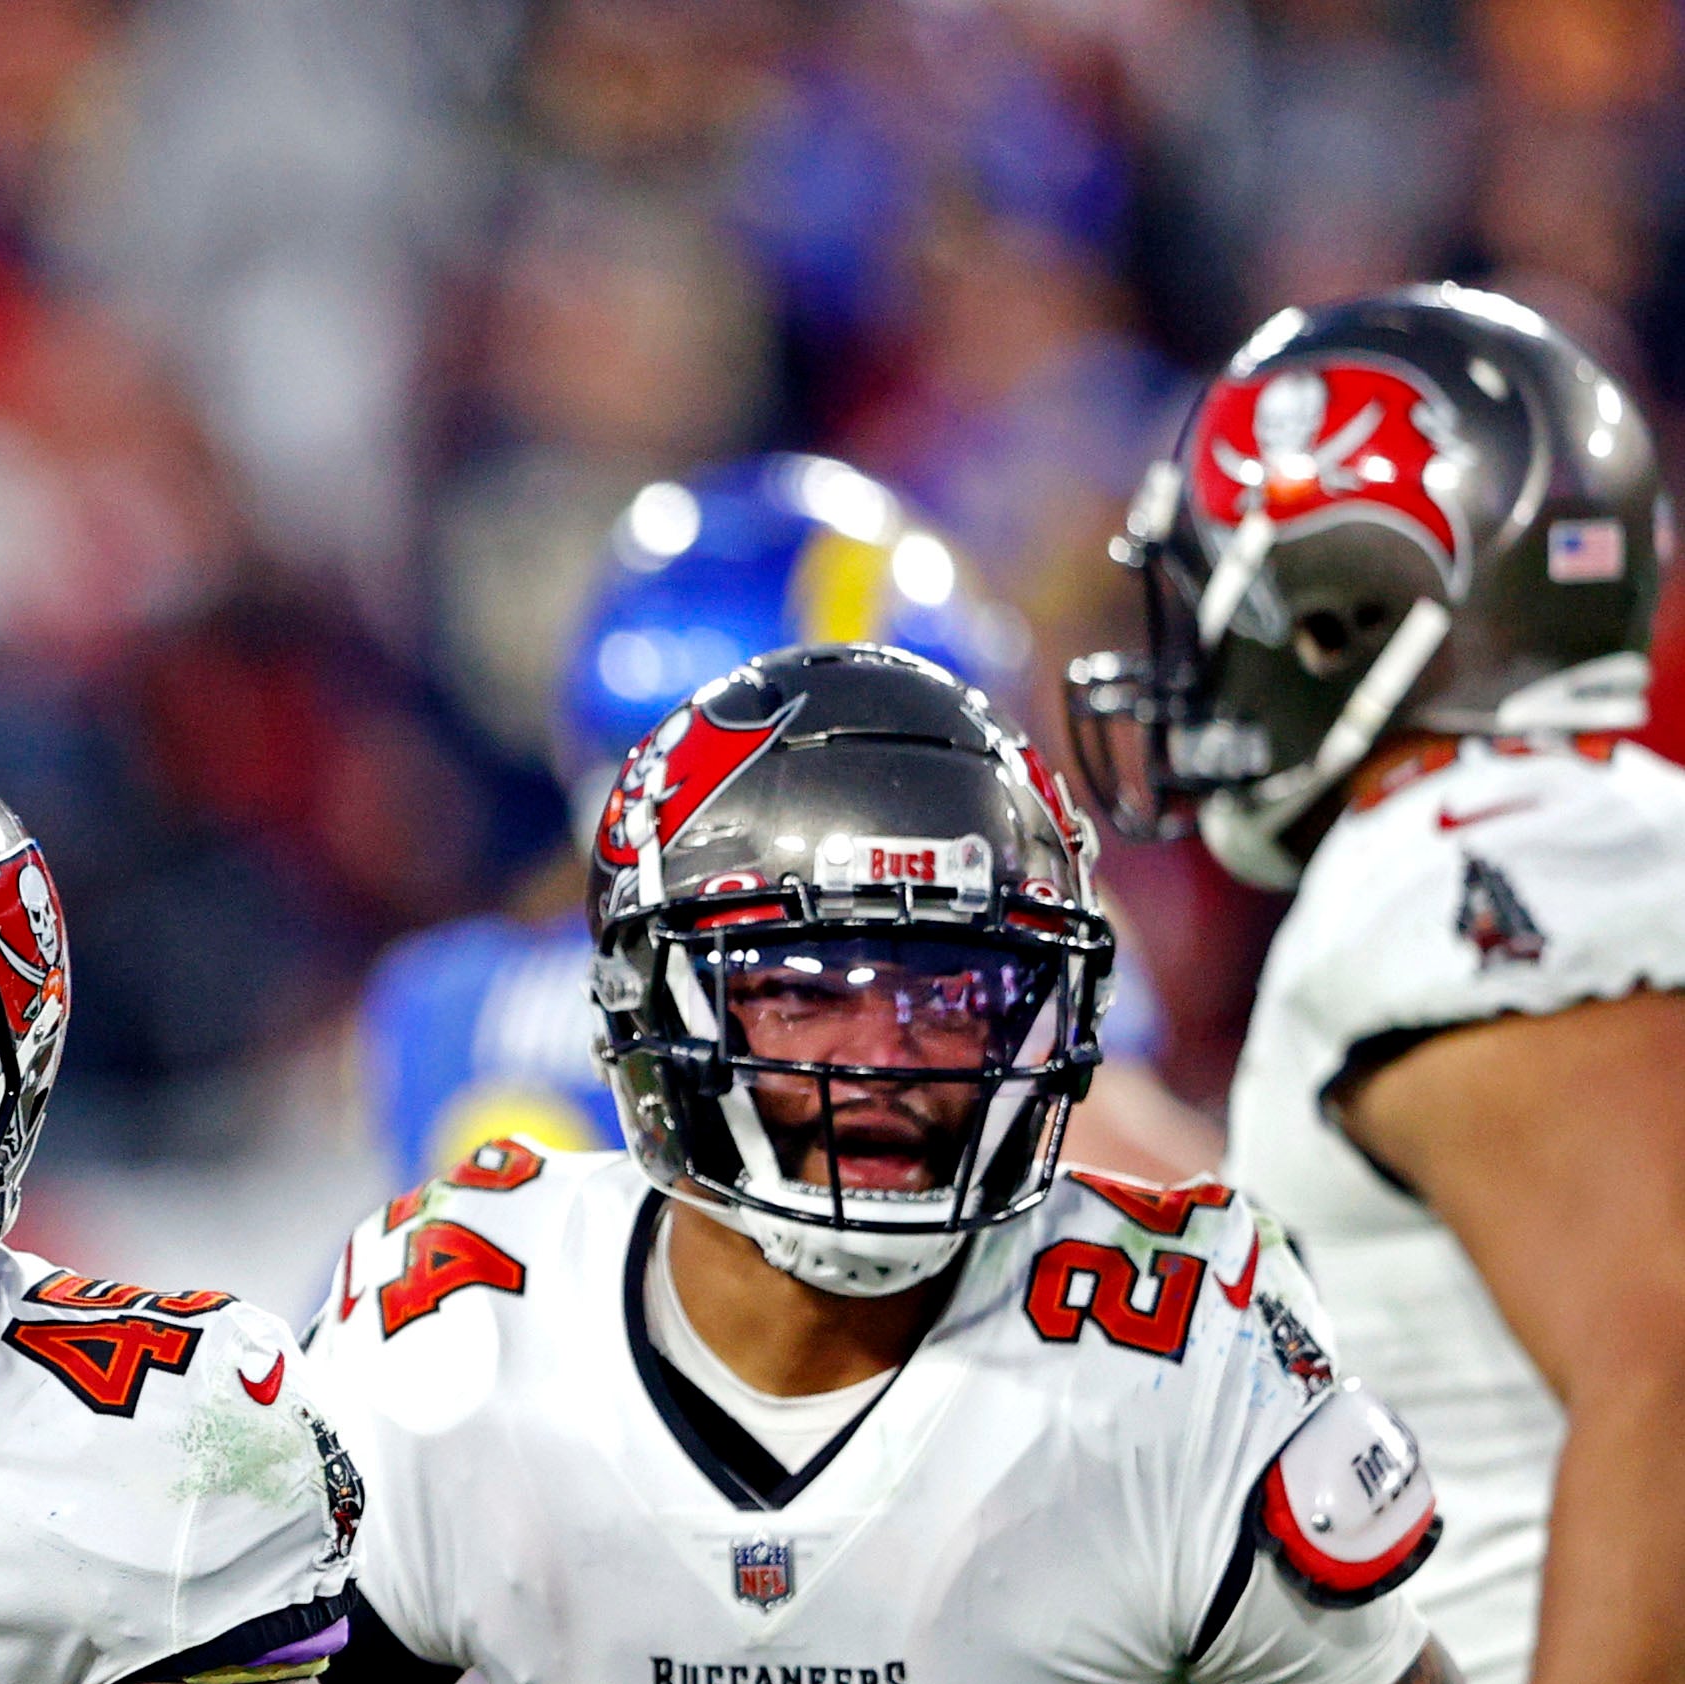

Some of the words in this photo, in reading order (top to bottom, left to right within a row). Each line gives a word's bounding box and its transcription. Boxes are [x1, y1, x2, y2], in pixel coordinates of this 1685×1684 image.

[1022, 1170, 1237, 1367] 24
[1, 1269, 241, 1419] 45
[738, 1568, 787, 1598] NFL
